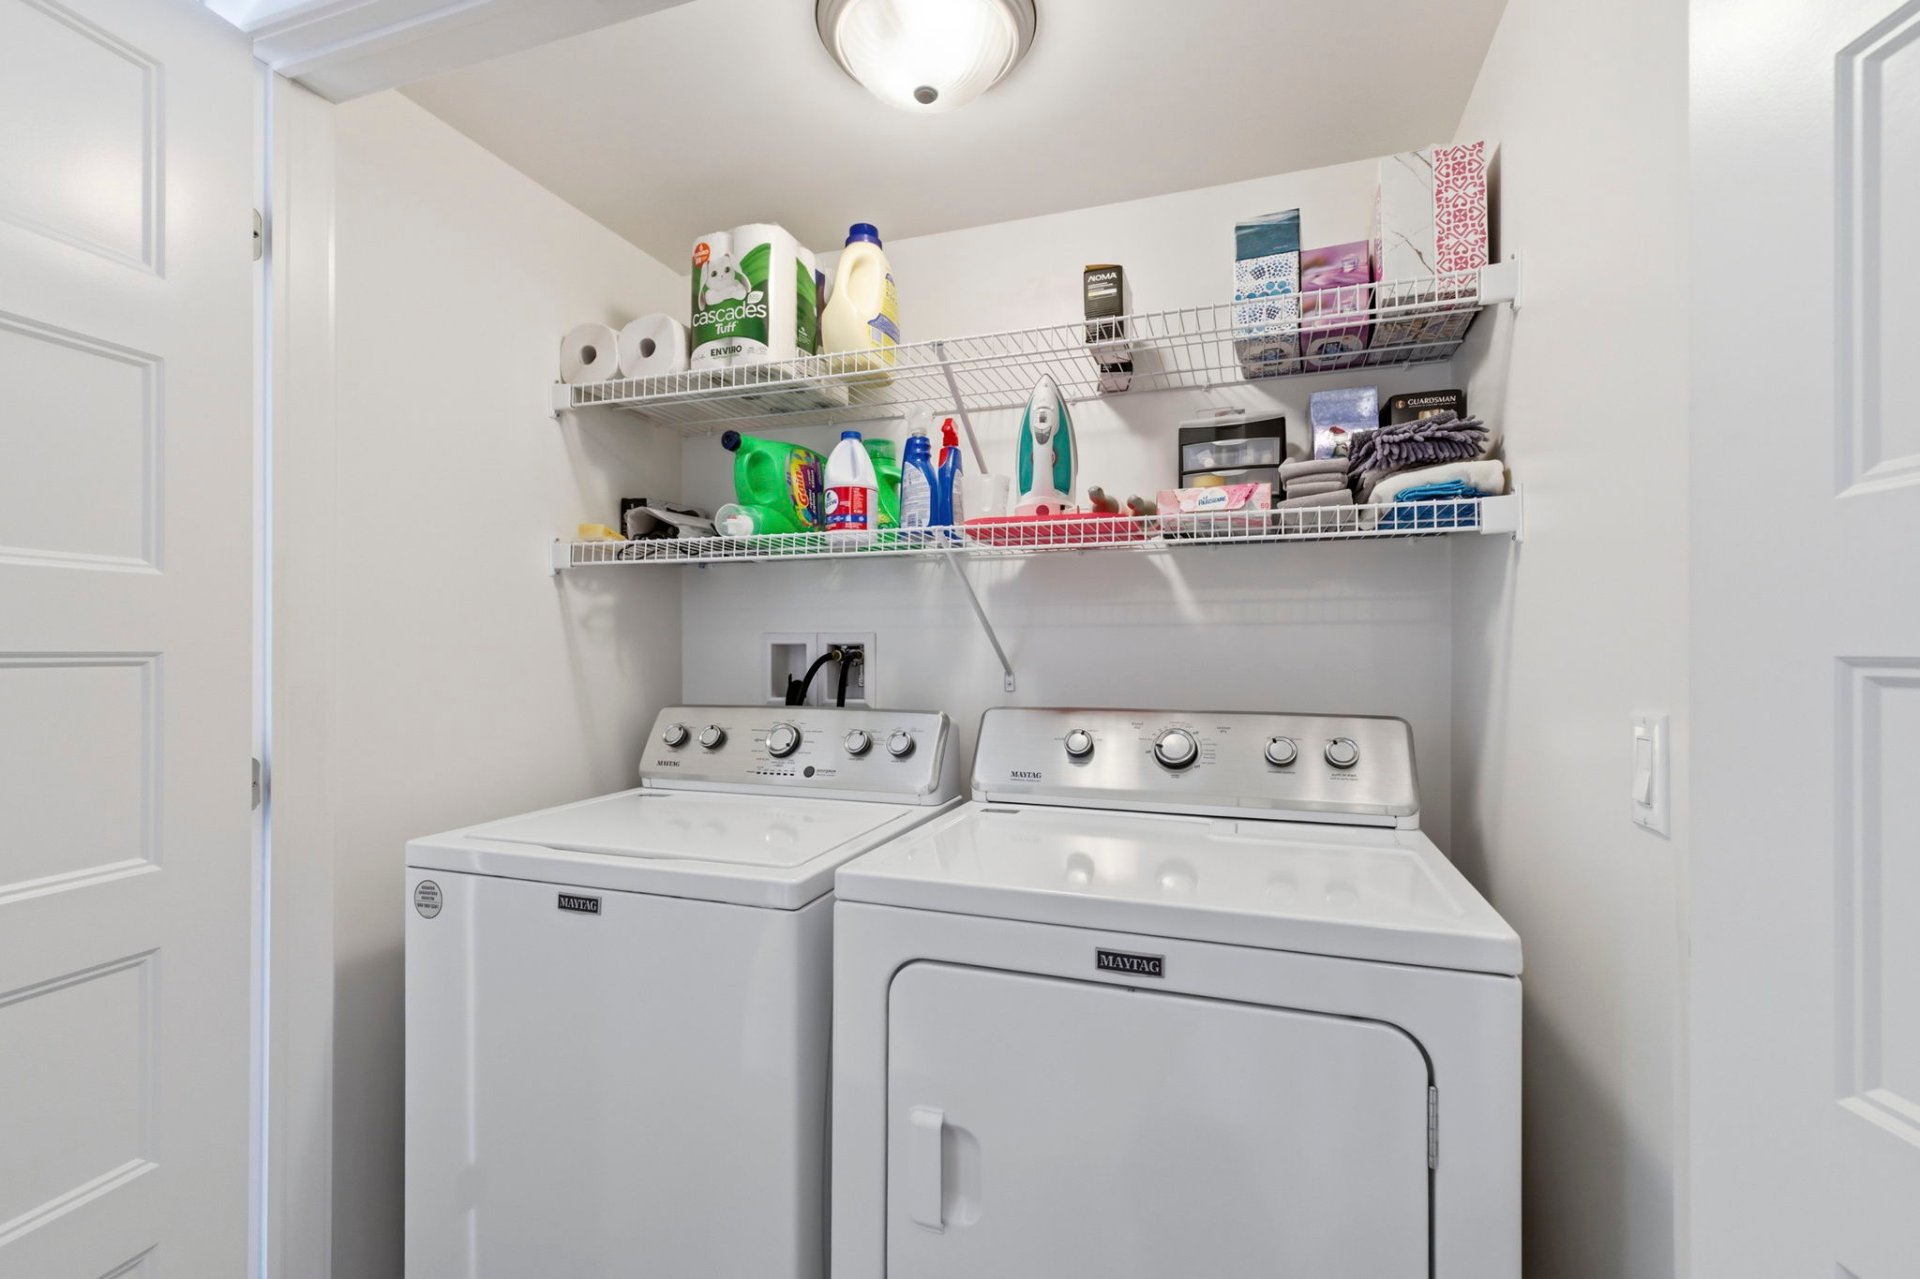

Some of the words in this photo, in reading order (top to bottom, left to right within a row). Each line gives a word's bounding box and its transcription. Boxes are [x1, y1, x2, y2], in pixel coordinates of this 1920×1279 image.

[1087, 272, 1118, 283] NOMA
[692, 300, 767, 328] cascades
[715, 322, 737, 335] Tuff
[710, 345, 742, 357] ENVIRO
[1407, 395, 1456, 406] GUARDSMAN
[796, 469, 809, 506] Gain
[1010, 770, 1042, 779] MAYTAG
[560, 897, 598, 911] MAYTAG
[1100, 954, 1160, 973] MAYTAG
